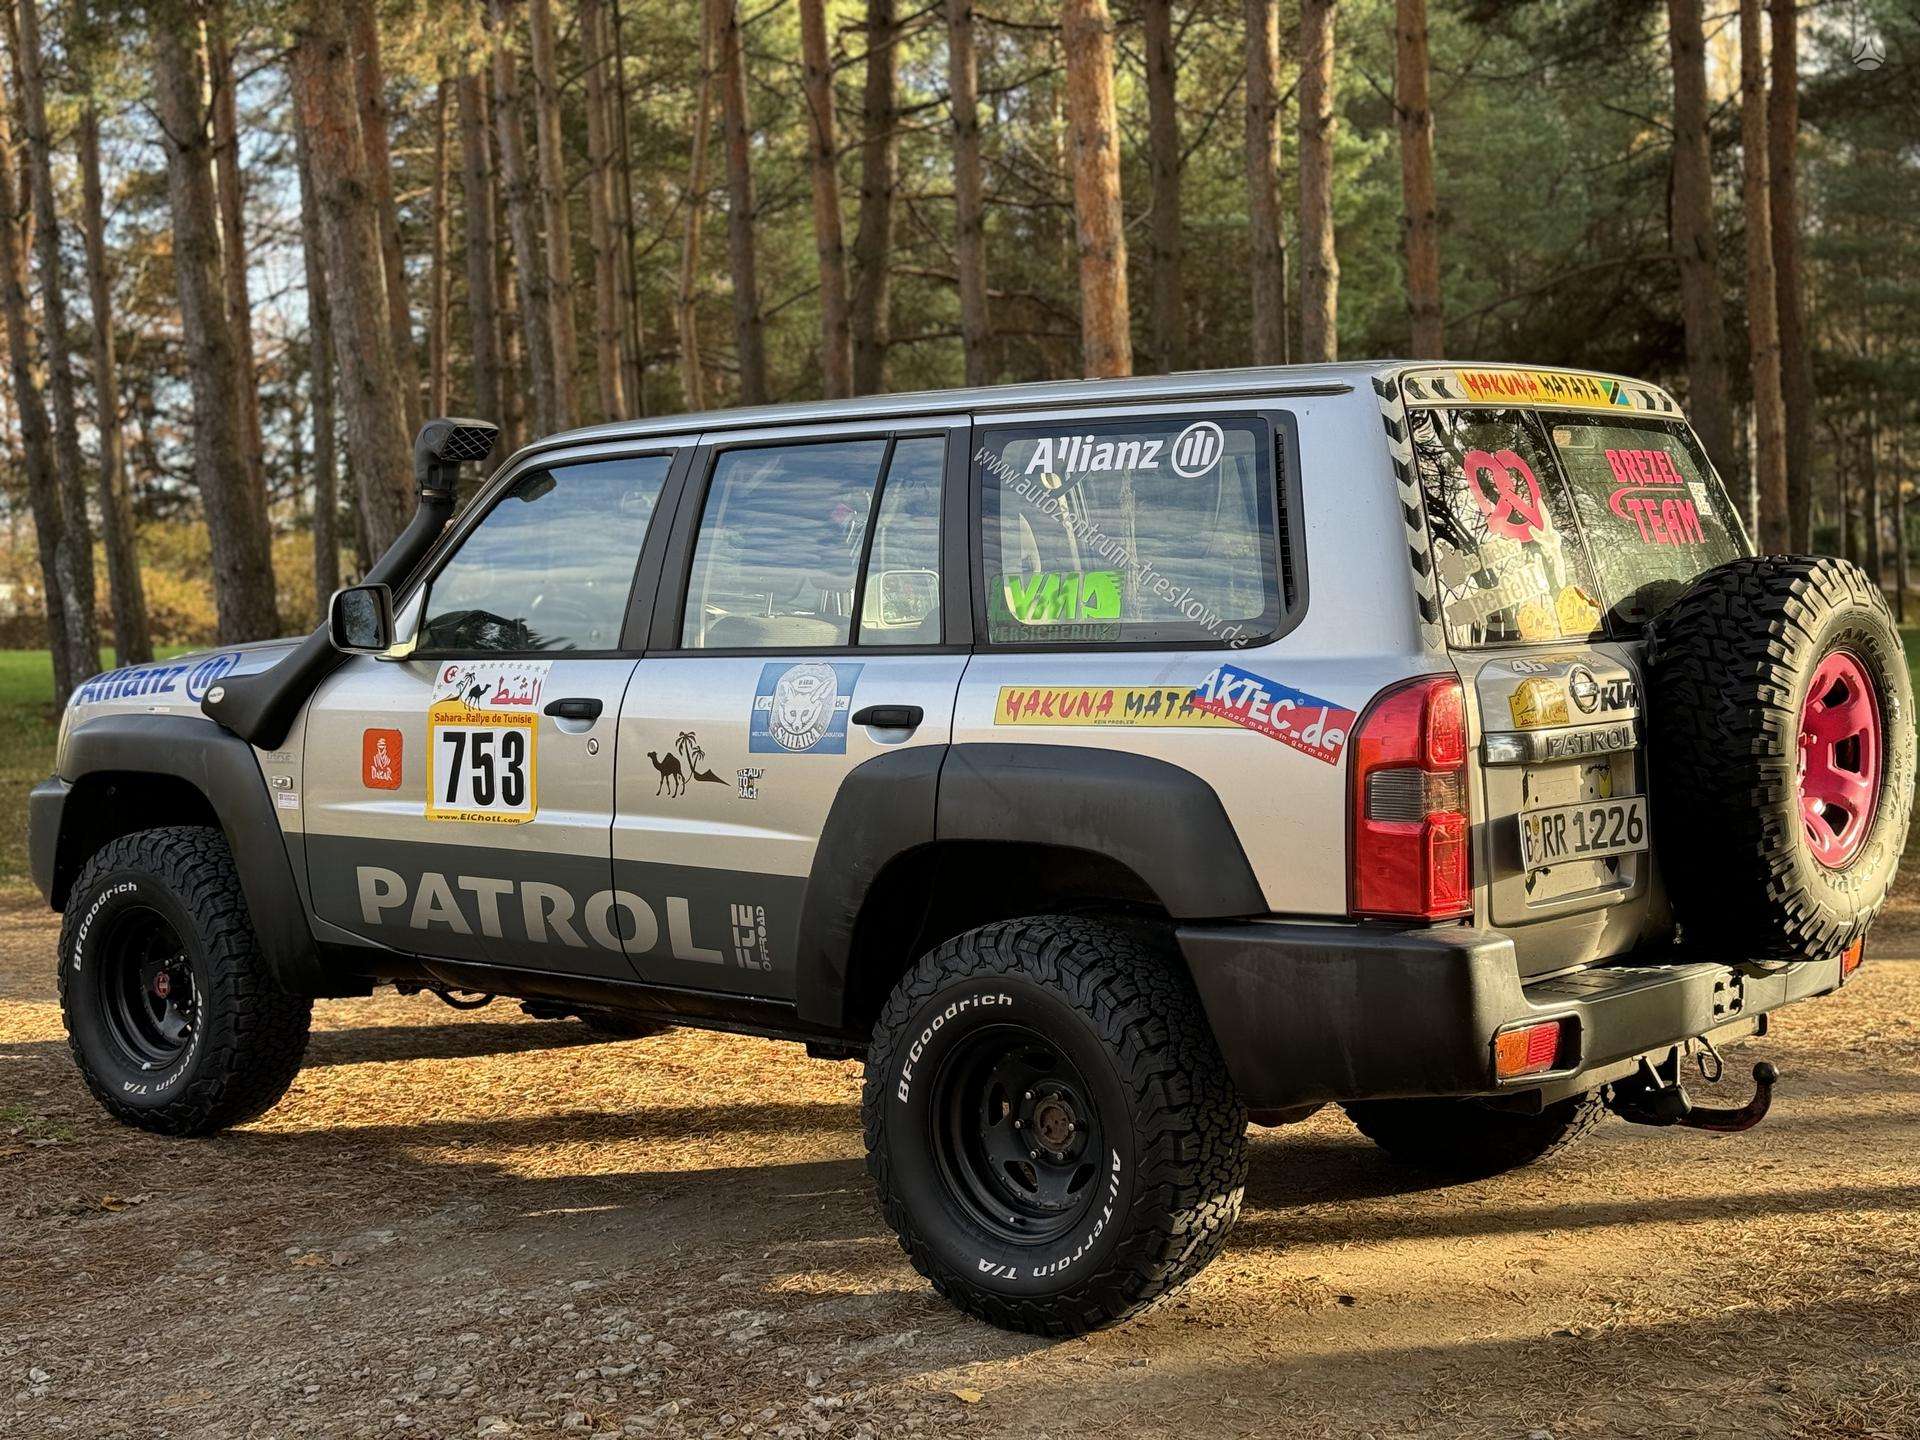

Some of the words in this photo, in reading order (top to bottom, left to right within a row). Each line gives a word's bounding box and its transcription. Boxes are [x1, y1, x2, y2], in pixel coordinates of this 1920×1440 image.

[1462, 371, 1539, 400] HAKUNA
[1538, 374, 1601, 401] MATATA
[1025, 435, 1164, 475] Allianz
[1604, 449, 1684, 487] BREZEL
[1626, 498, 1706, 549] TEAM
[75, 664, 189, 707] Allianz
[1124, 690, 1217, 720] MATA
[1600, 678, 1640, 712] KTM
[434, 712, 490, 725] Sahara-Rallye
[491, 713, 502, 723] de
[503, 714, 532, 724] Tunisie
[1006, 689, 1114, 722] HAKUNA
[775, 727, 821, 749] SAHARA
[1548, 726, 1637, 757] PATROL
[443, 731, 524, 807] 753
[1541, 813, 1569, 858] RR
[1572, 803, 1644, 853] 1226
[74, 881, 138, 972] BFGoodrich
[356, 866, 724, 966] PATROL
[897, 993, 1013, 1104] BFGoodrich
[1032, 1148, 1122, 1279] All-Terrain
[977, 1257, 1019, 1280] T/A
